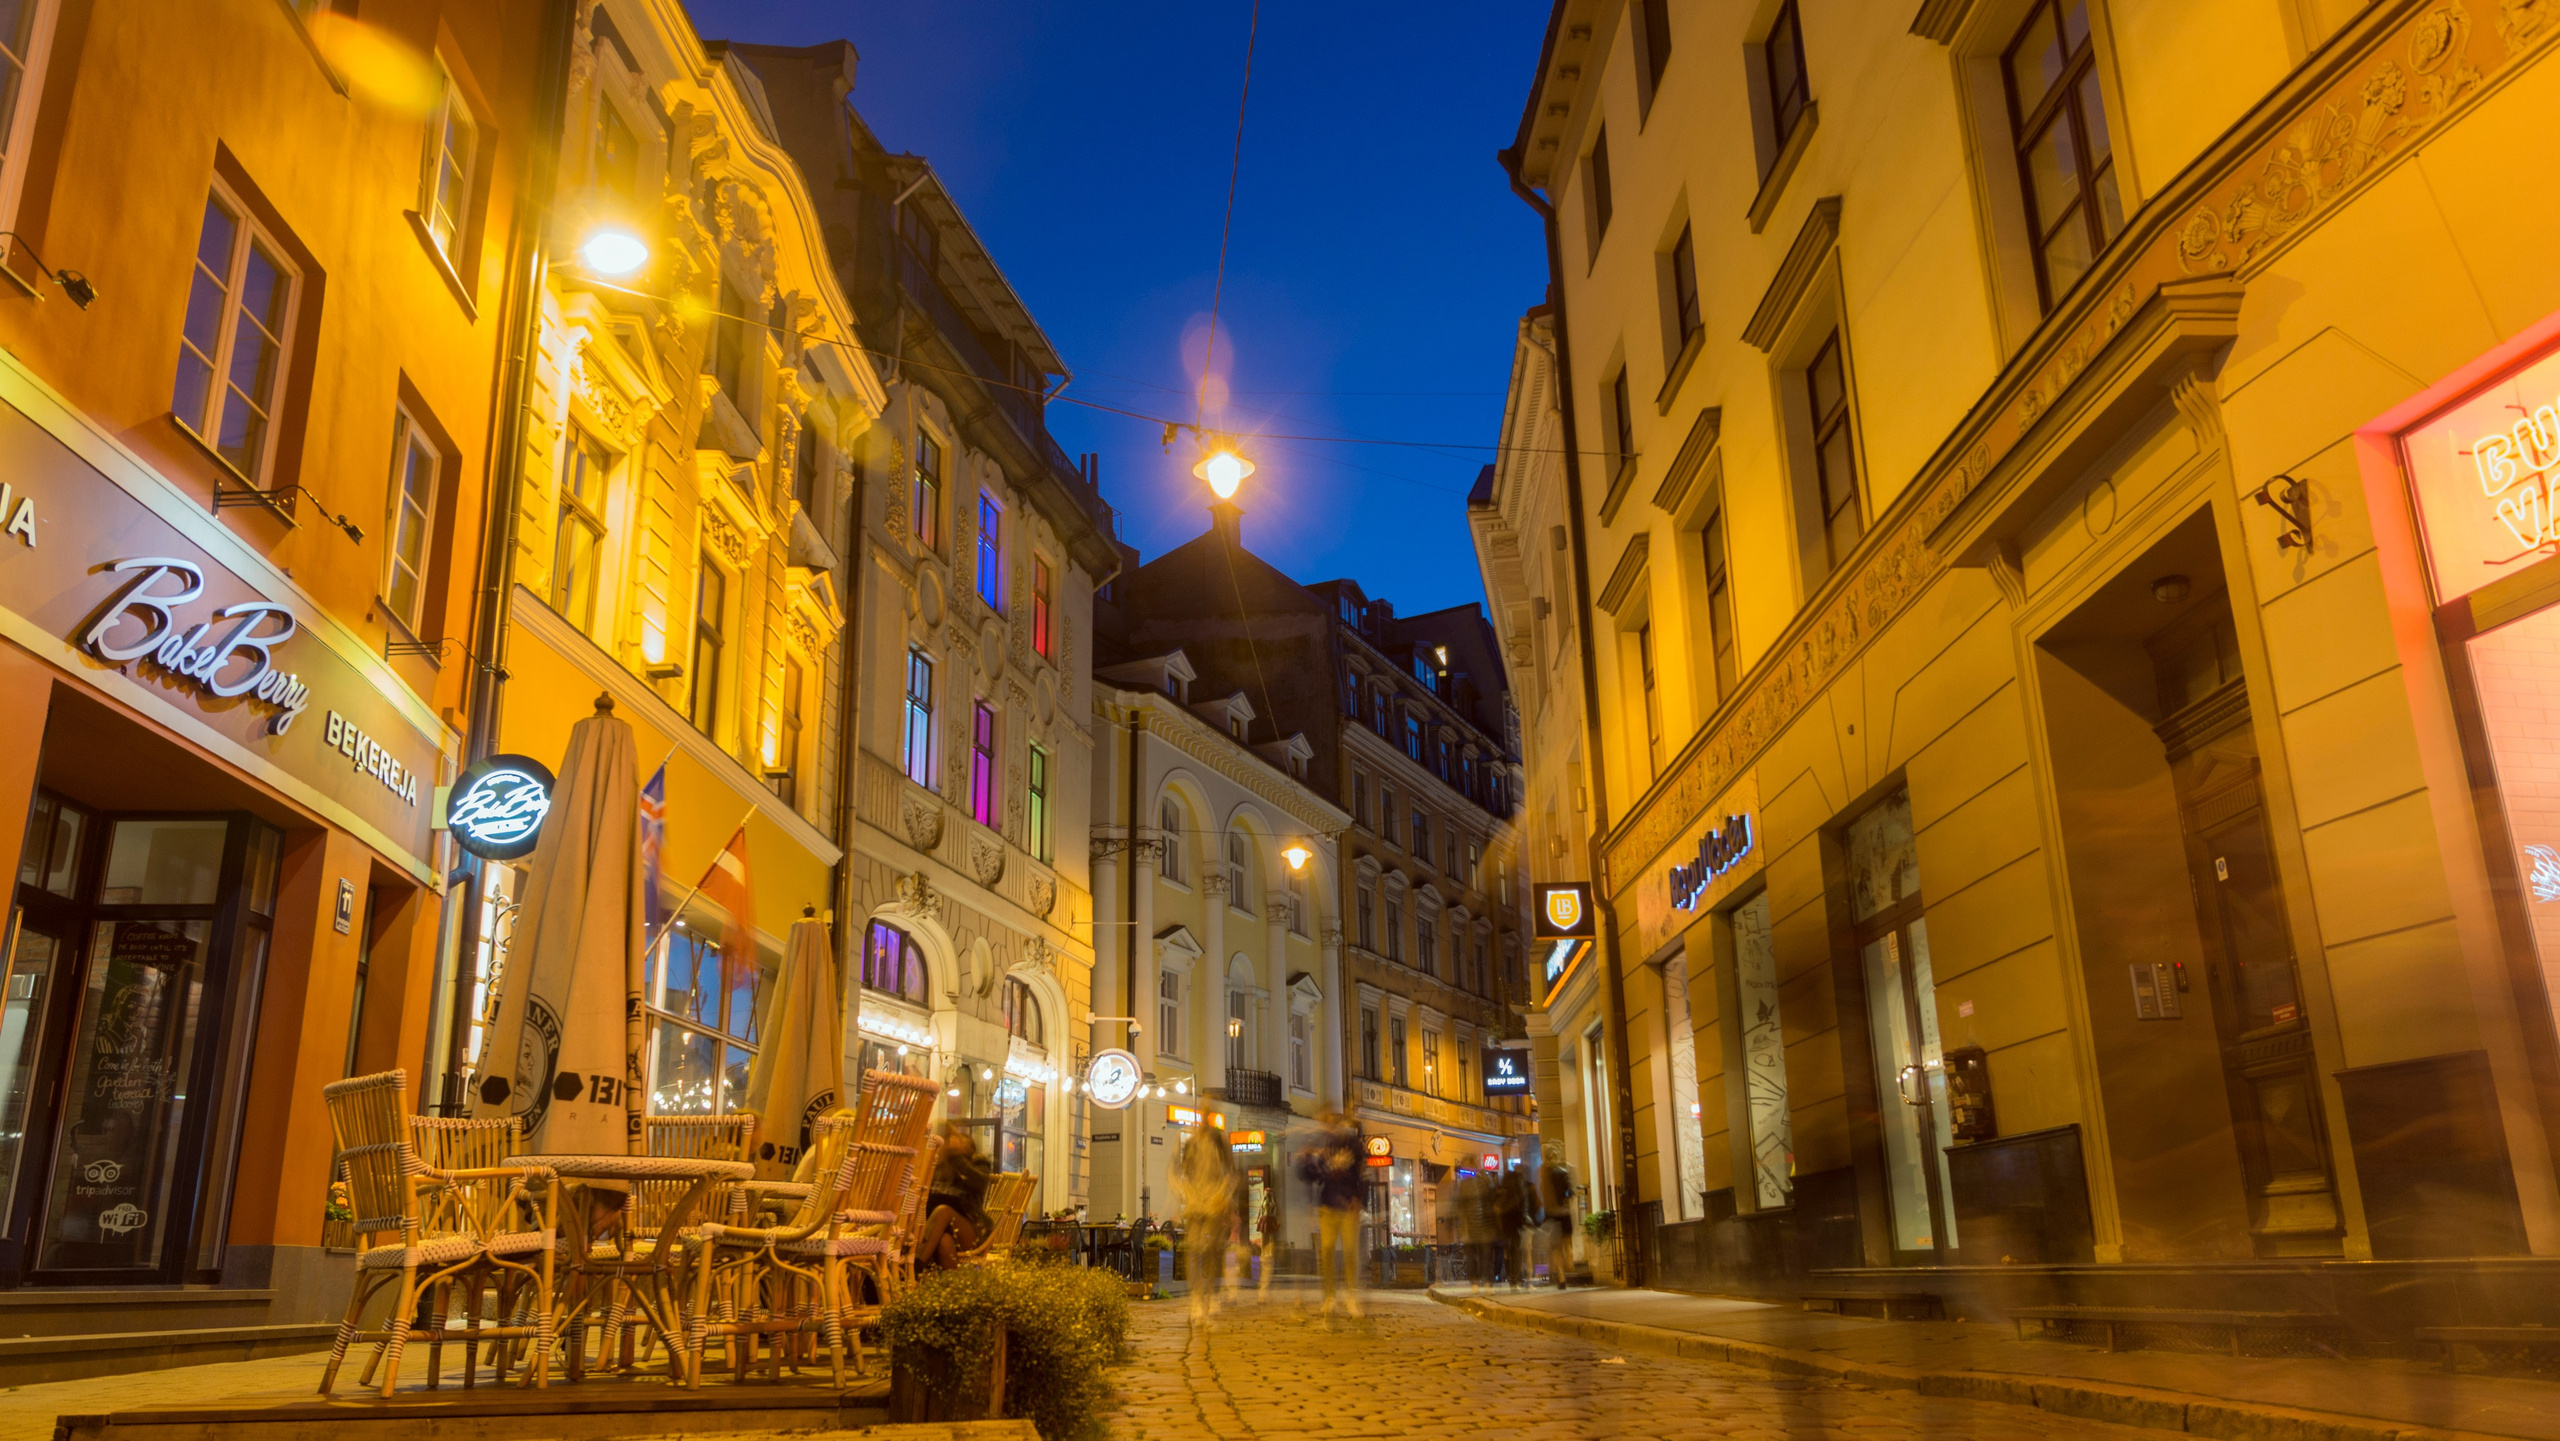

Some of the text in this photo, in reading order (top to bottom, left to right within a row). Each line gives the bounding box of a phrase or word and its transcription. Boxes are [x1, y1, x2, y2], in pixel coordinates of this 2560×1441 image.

[86, 557, 310, 736] BakeBerry
[327, 710, 417, 807] BEĶEREJA
[342, 891, 353, 914] 11
[1556, 898, 1573, 915] LB
[127, 933, 157, 941] COFFEE
[97, 1056, 120, 1071] Come
[1484, 1156, 1498, 1169] illy
[76, 1185, 136, 1198] tripadvisor
